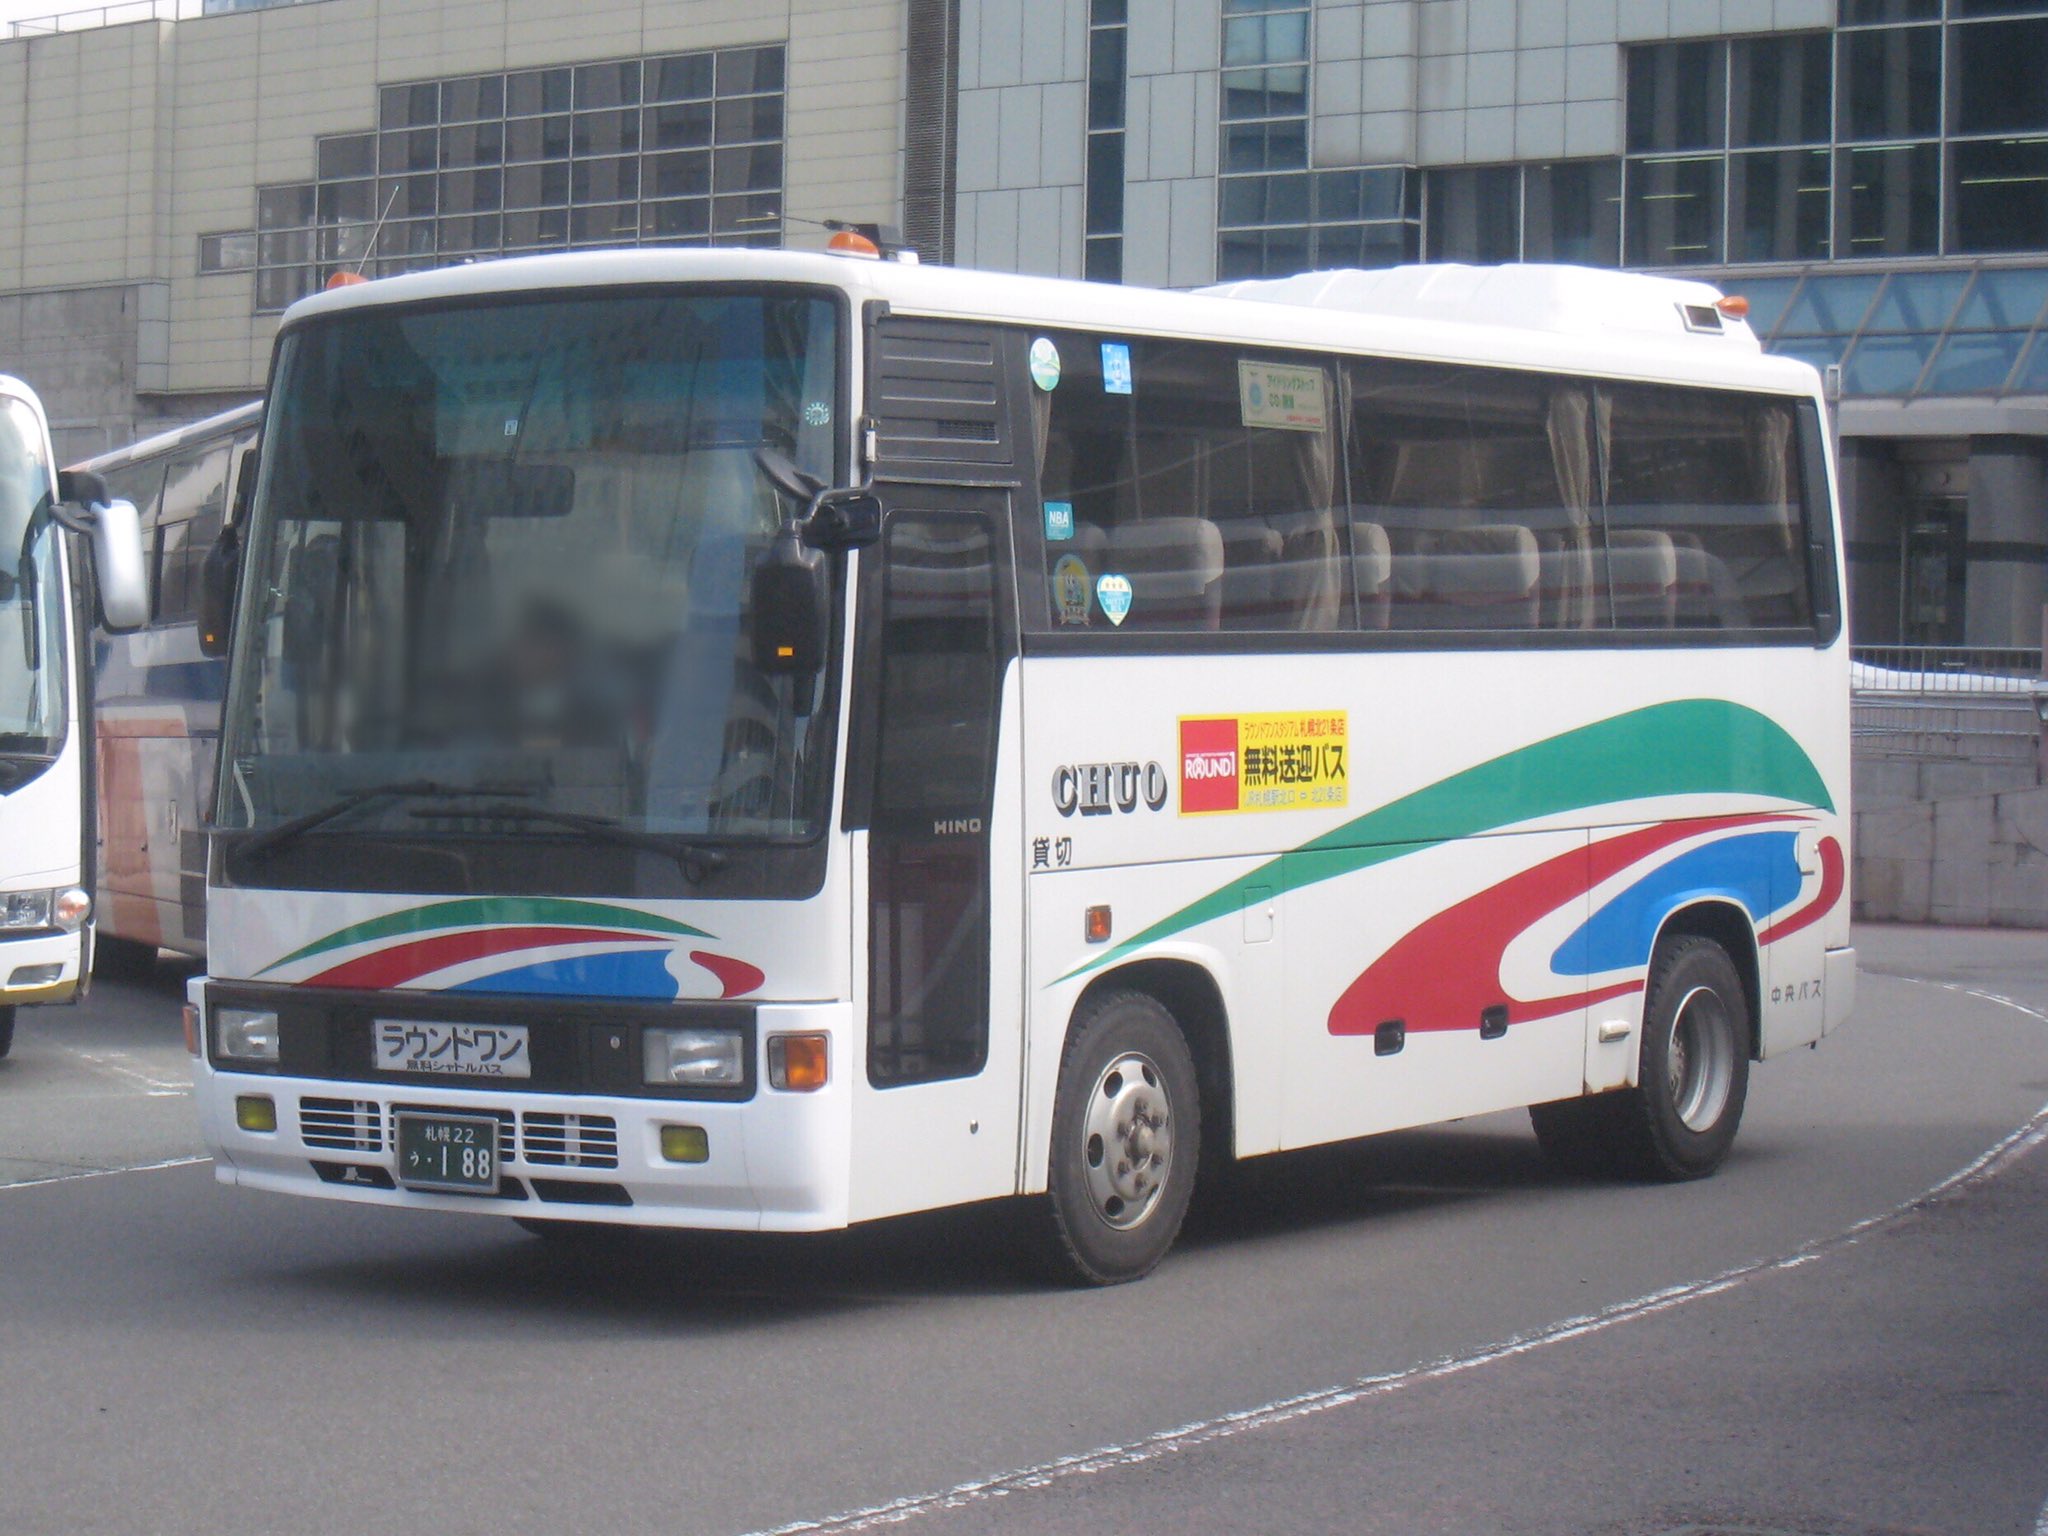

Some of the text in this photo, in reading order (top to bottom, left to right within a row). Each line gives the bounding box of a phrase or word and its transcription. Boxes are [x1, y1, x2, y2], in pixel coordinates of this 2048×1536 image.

[1049, 510, 1069, 526] NBA
[1244, 744, 1346, 786] 無料送迎バス
[1051, 760, 1168, 818] CHUO
[934, 818, 982, 835] HINO
[1032, 836, 1073, 869] 貸切
[1771, 979, 1822, 1005] 中央バス
[382, 1025, 523, 1062] ラウンドワン
[406, 1059, 504, 1075] 無料シャトルバス
